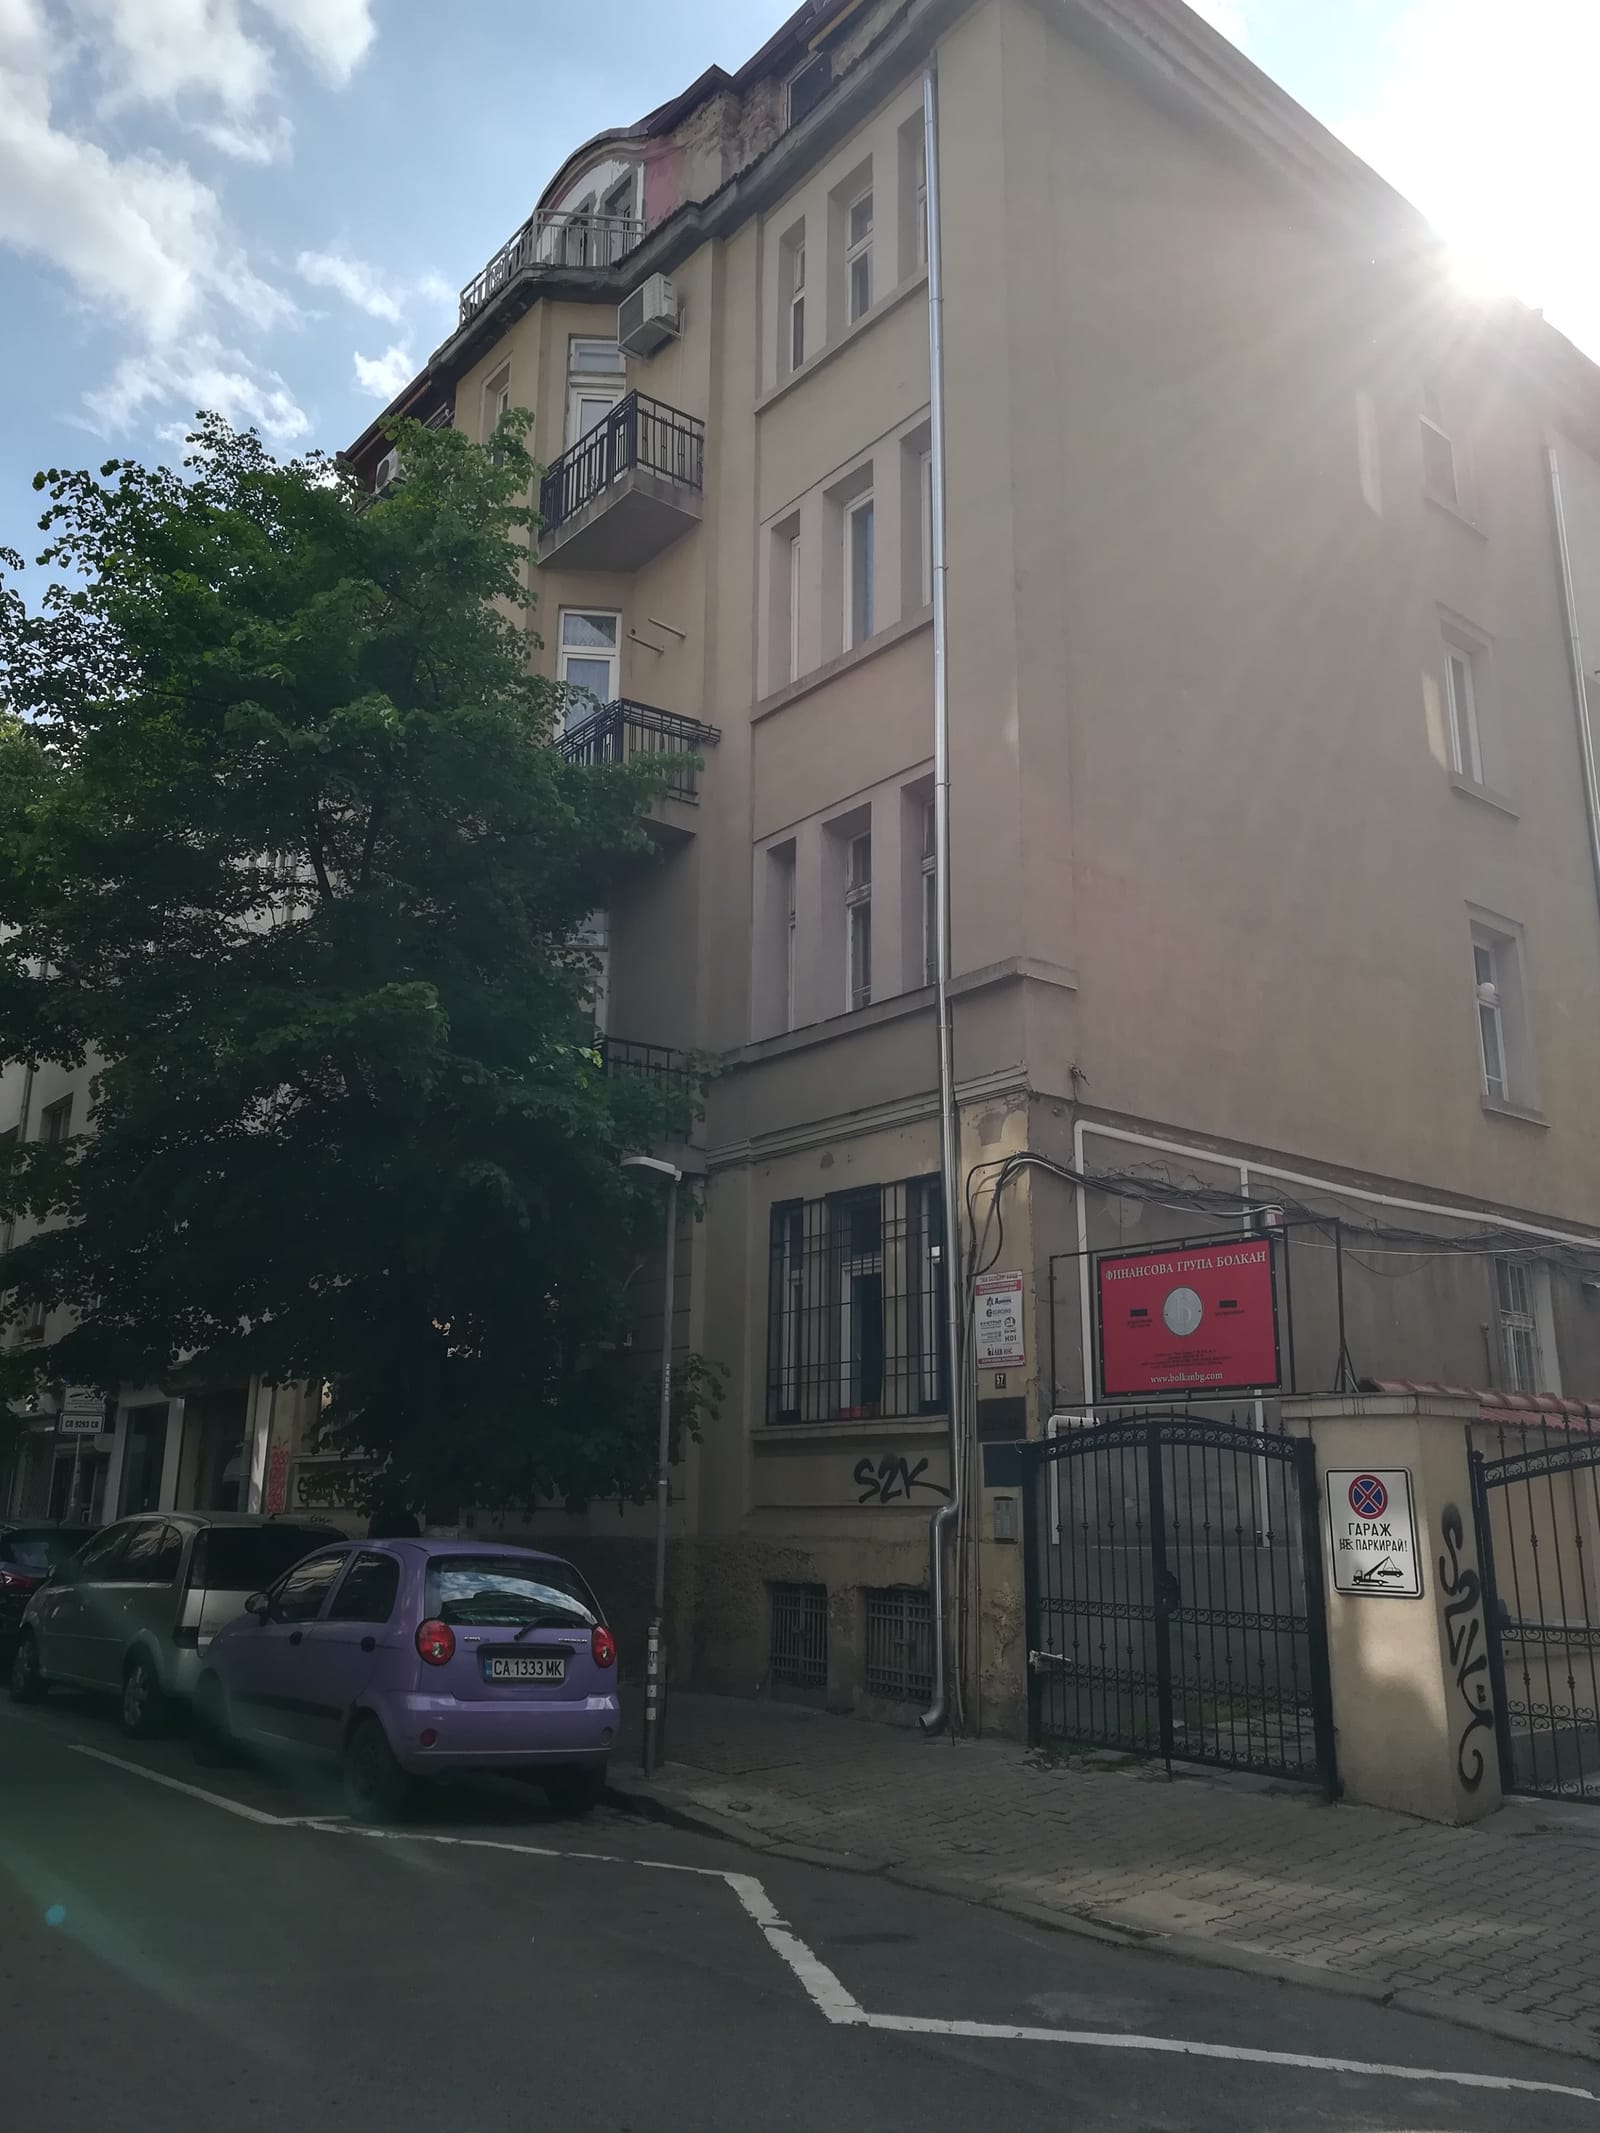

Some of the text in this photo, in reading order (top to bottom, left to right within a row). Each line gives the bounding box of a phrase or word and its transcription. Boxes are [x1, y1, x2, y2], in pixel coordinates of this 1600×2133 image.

[1105, 1251, 1266, 1281] ФИНАНСОВА ГРУПА БОЛКАН
[1348, 1522, 1392, 1537] ГАРАЖ
[1355, 1538, 1408, 1552] ПАРКИРАЙ!
[494, 1660, 562, 1676] CA 1333 MK
